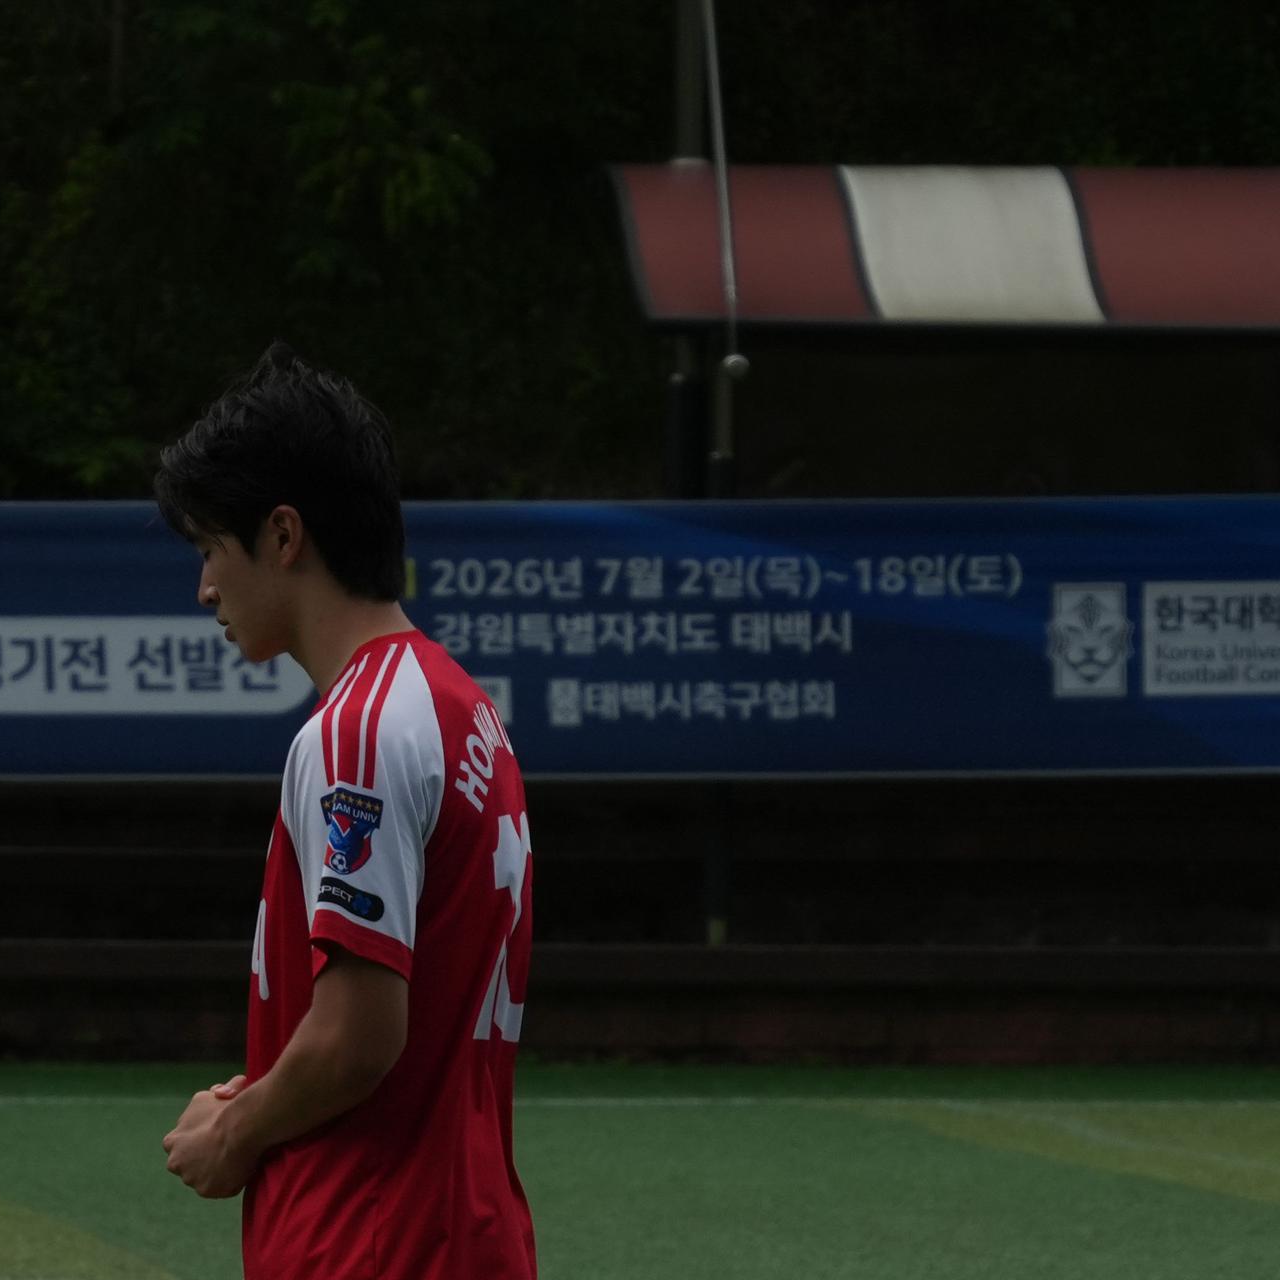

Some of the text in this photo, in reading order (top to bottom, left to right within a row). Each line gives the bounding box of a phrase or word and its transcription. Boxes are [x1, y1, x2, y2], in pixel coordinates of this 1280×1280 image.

[429, 557, 583, 600] 2026년
[593, 556, 664, 600] 7월
[431, 609, 854, 656] 강원특별자치도 태백시
[1155, 644, 1217, 661] Korea
[1155, 664, 1238, 683] Football
